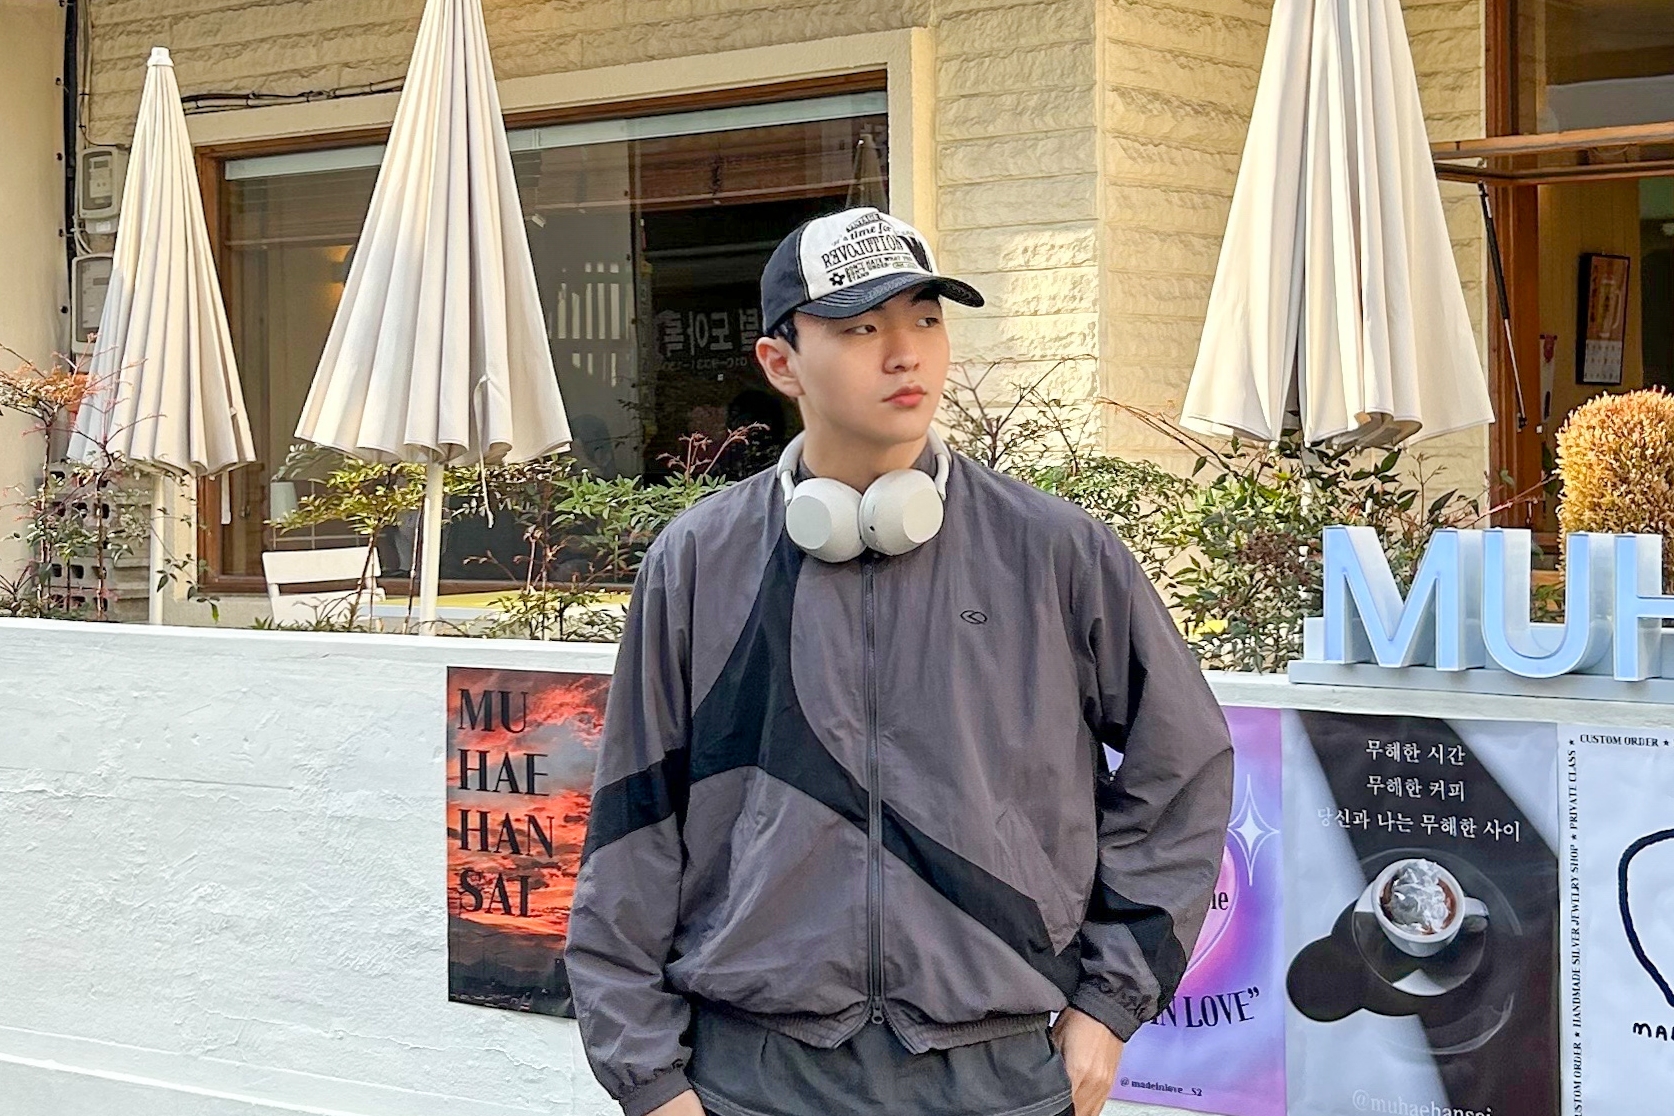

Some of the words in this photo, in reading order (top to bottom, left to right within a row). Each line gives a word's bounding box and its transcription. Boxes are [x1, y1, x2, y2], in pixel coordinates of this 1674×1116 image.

[850, 226, 876, 240] time
[458, 688, 528, 734] MU
[1366, 739, 1421, 763] 무해한
[1427, 744, 1466, 766] 시간
[1580, 733, 1622, 746] CUSTOM
[1624, 736, 1659, 748] ORDER
[458, 748, 549, 796] HAE
[1568, 750, 1577, 782] CLASS
[1366, 775, 1423, 799] 무해한
[1429, 780, 1465, 802] 커피
[1317, 807, 1371, 830] 당신과
[1377, 811, 1414, 833] 나는
[1419, 815, 1477, 839] 무해한
[1483, 818, 1520, 843] 사이
[1569, 785, 1579, 830] PRIVATE
[458, 809, 554, 858] HAN
[1570, 844, 1580, 873] SHOP
[459, 867, 531, 918] SAI
[1571, 874, 1580, 926] JEWELRY
[1571, 928, 1581, 966] SILVER
[1572, 967, 1582, 1028] HANDMADE
[1573, 1041, 1582, 1077] ORDER
